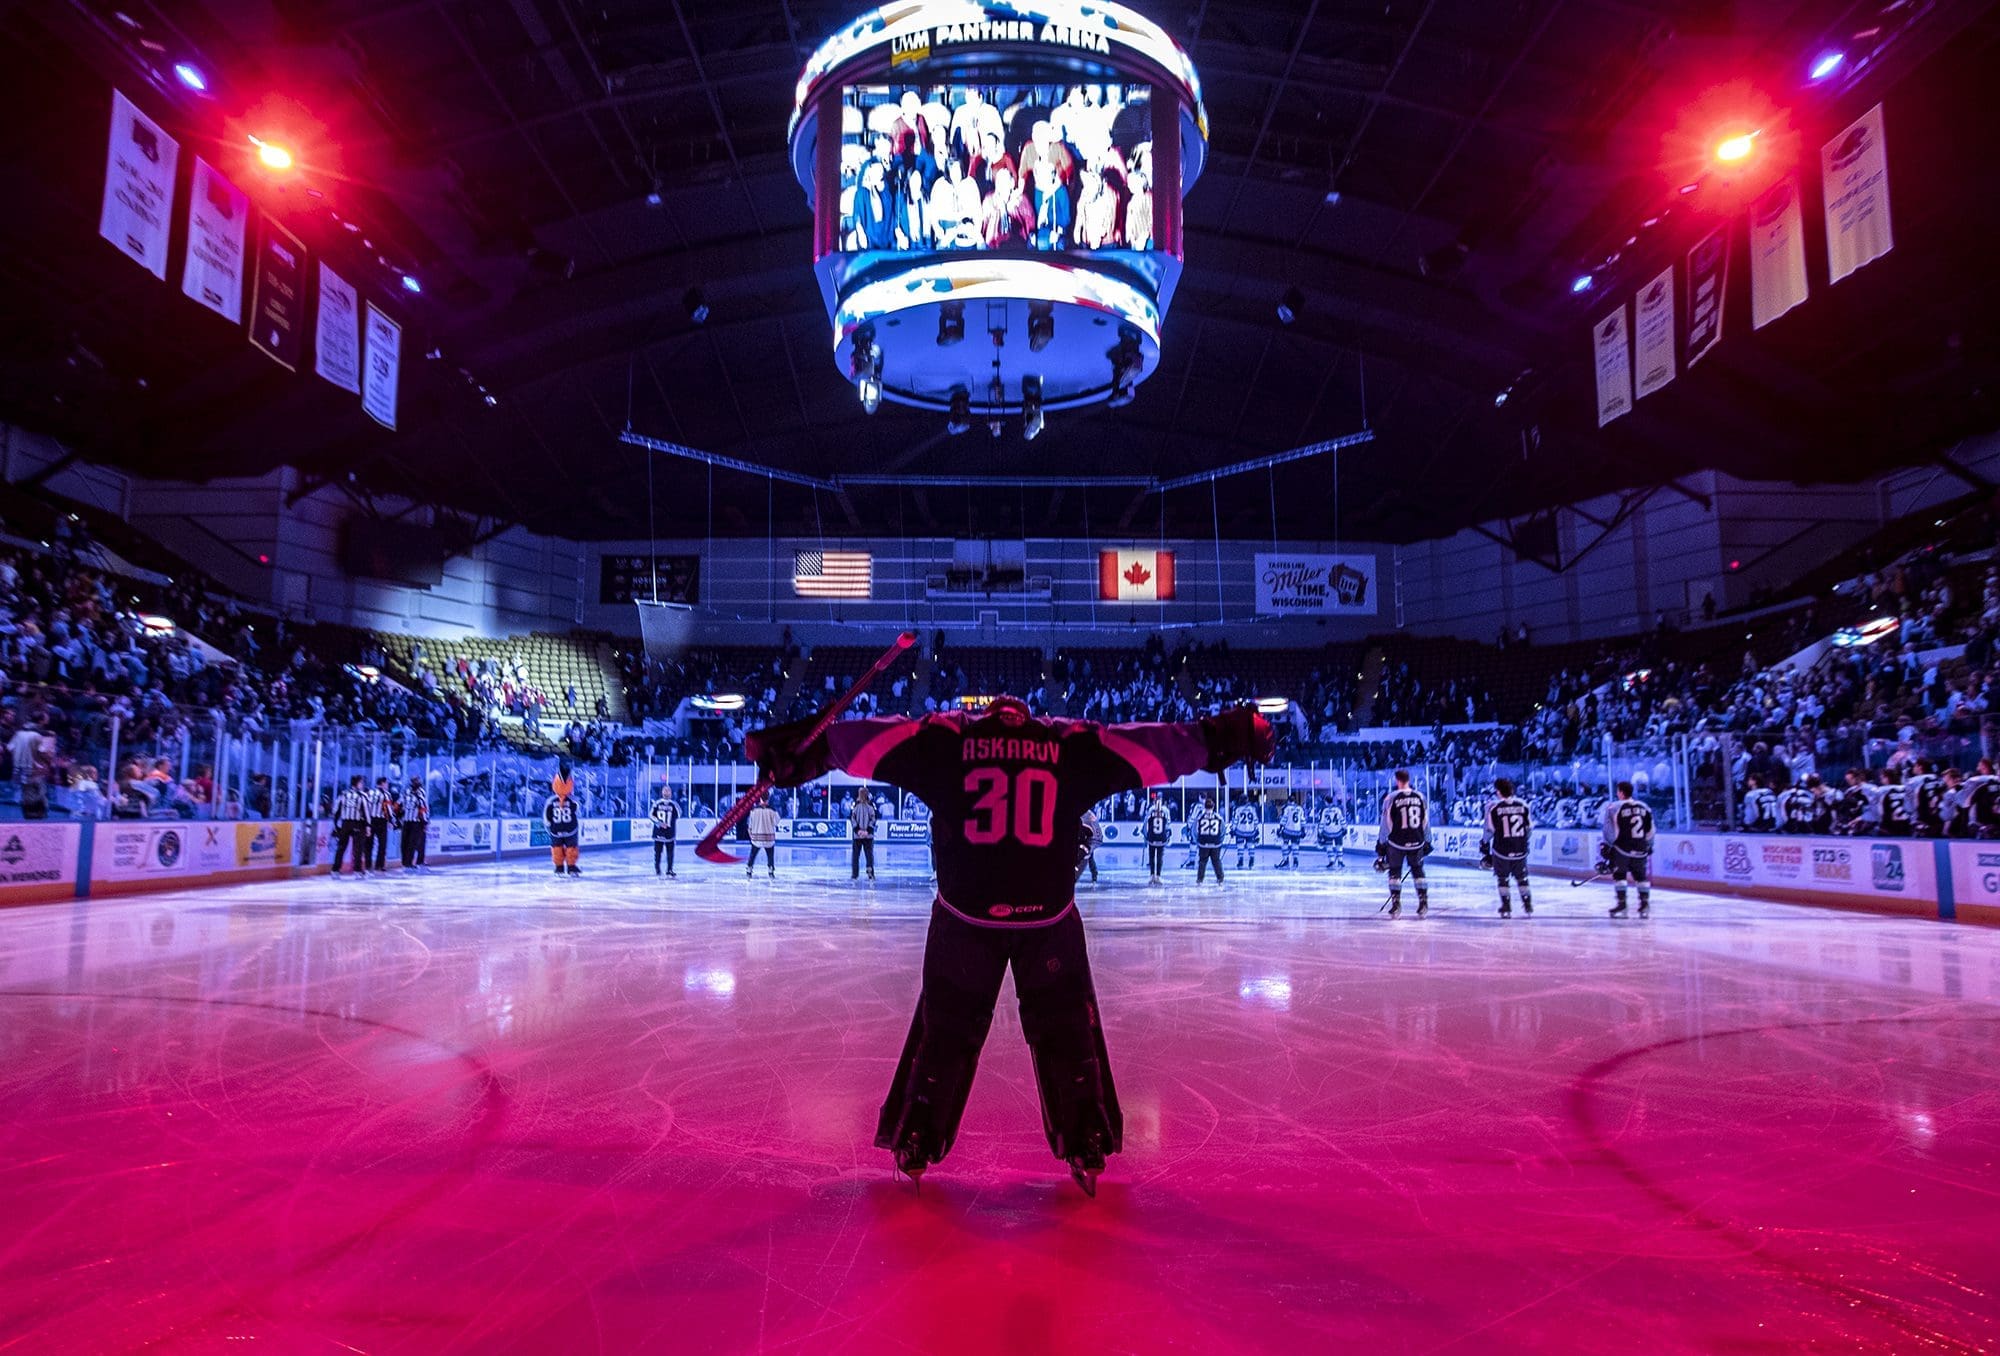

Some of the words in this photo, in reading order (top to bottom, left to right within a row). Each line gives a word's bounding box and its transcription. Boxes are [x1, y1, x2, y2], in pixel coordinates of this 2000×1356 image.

[892, 31, 930, 55] UWM
[936, 20, 1034, 46] PANTHER
[1040, 24, 1110, 55] ARENA
[1262, 567, 1326, 594] Miller
[1296, 584, 1330, 598] TIME,
[1271, 598, 1324, 608] WISCONSIN
[962, 738, 1060, 764] ASKAROV
[552, 807, 573, 824] 98
[964, 767, 1058, 847] 30
[656, 810, 673, 829] 91
[1152, 817, 1163, 834] 9
[1239, 812, 1254, 825] 29
[1291, 812, 1299, 824] 6
[1324, 813, 1340, 826] 34
[1399, 806, 1421, 829] 18
[1199, 819, 1220, 834] 23
[1501, 815, 1525, 838] 12
[1630, 816, 1645, 839] 2
[1726, 841, 1748, 857] BIG
[1763, 854, 1784, 863] STATE
[1885, 862, 1905, 880] 24
